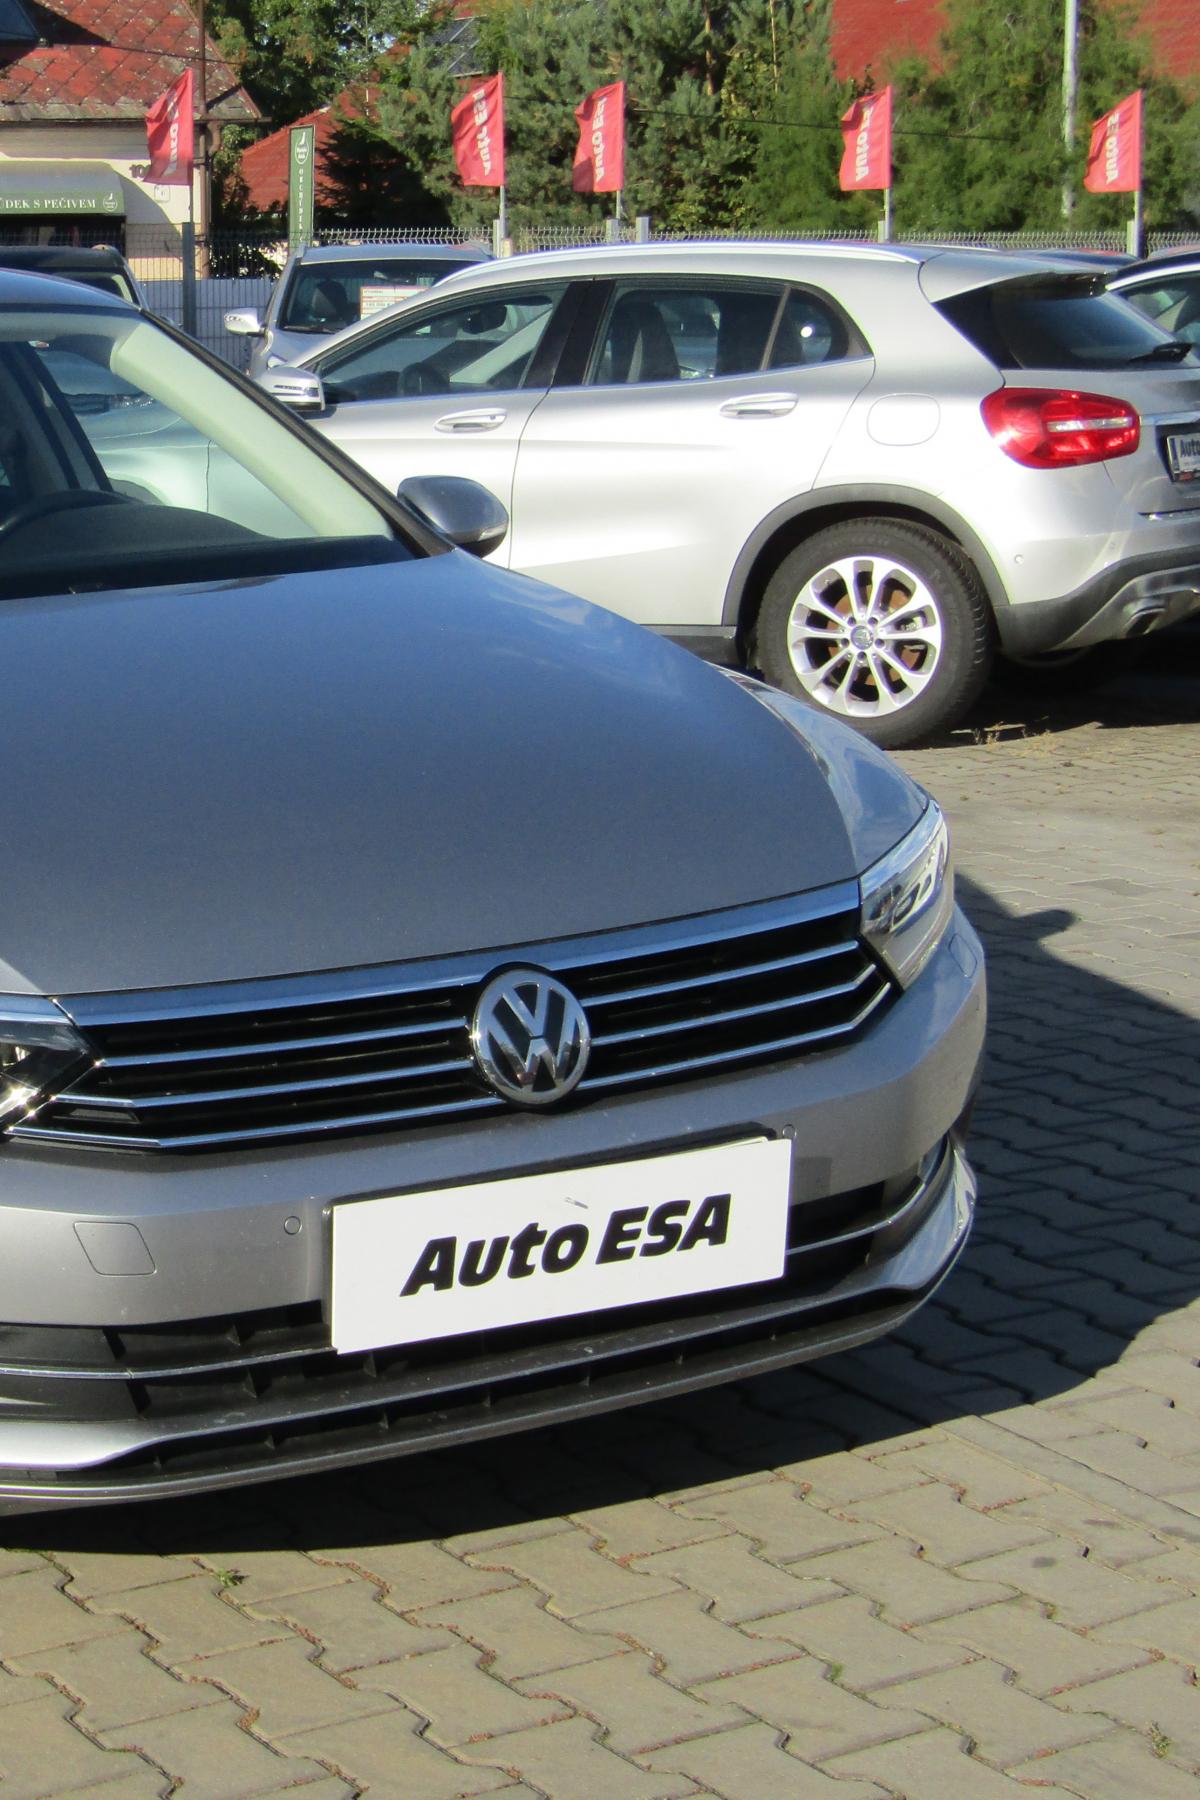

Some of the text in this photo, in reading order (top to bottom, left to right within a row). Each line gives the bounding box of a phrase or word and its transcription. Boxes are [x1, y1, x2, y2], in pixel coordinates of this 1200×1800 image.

[33, 199, 40, 209] S
[44, 197, 96, 209] PEČIVEM
[399, 1193, 732, 1298] Auto ESA
